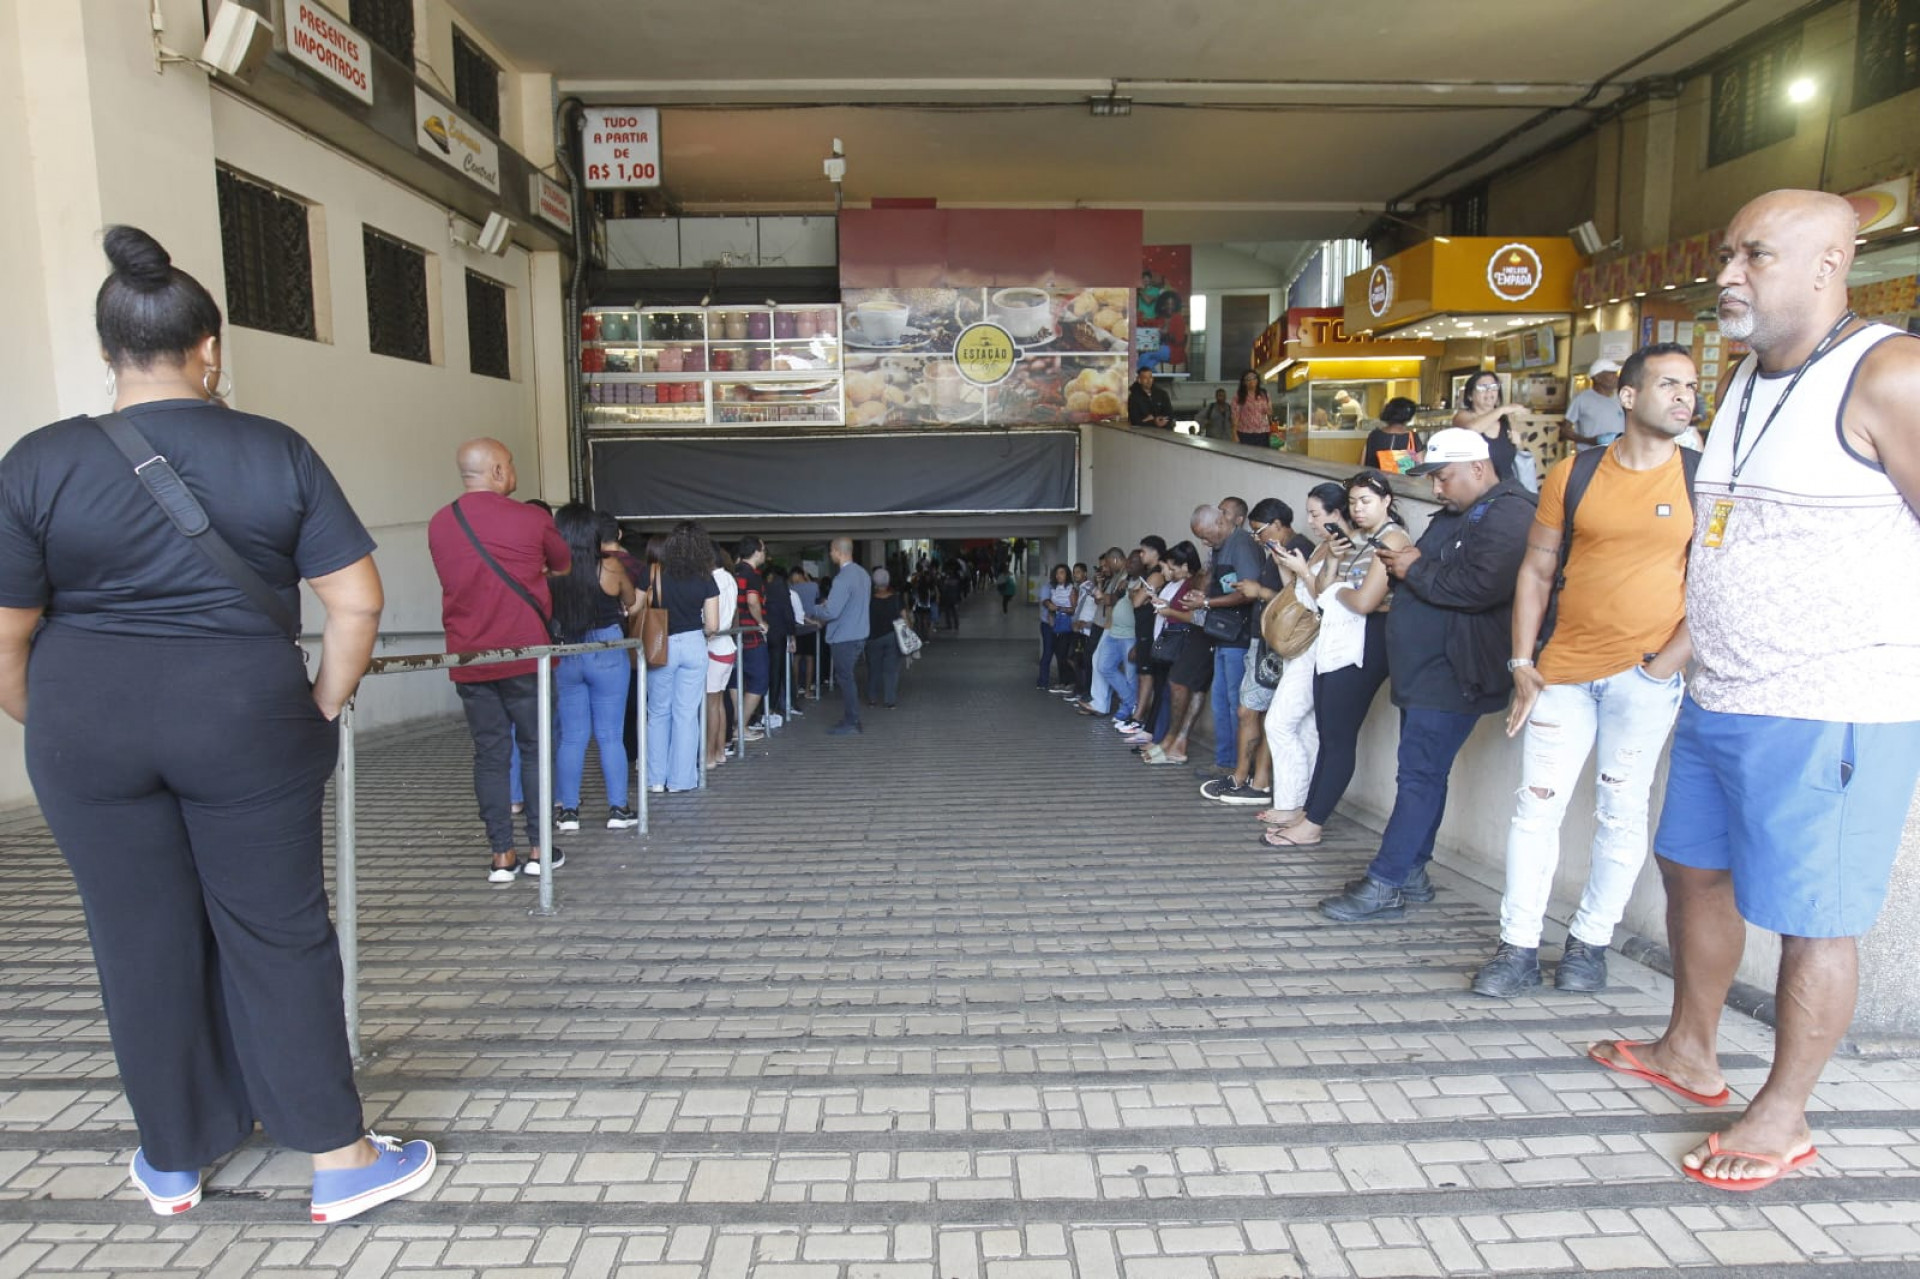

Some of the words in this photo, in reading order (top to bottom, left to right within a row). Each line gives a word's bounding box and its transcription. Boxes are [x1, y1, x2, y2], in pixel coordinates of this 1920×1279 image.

[299, 5, 360, 62] PRESENTES
[294, 26, 367, 91] IMPORTADOS
[603, 116, 638, 128] TUDO
[593, 132, 602, 144] A
[606, 132, 649, 144] PARTIR
[614, 148, 631, 159] DE
[463, 151, 497, 186] Central
[588, 162, 611, 181] R$
[617, 163, 655, 183] 1,00
[1494, 271, 1532, 286] EMPADA
[963, 347, 1007, 360] ESTAÇÃO
